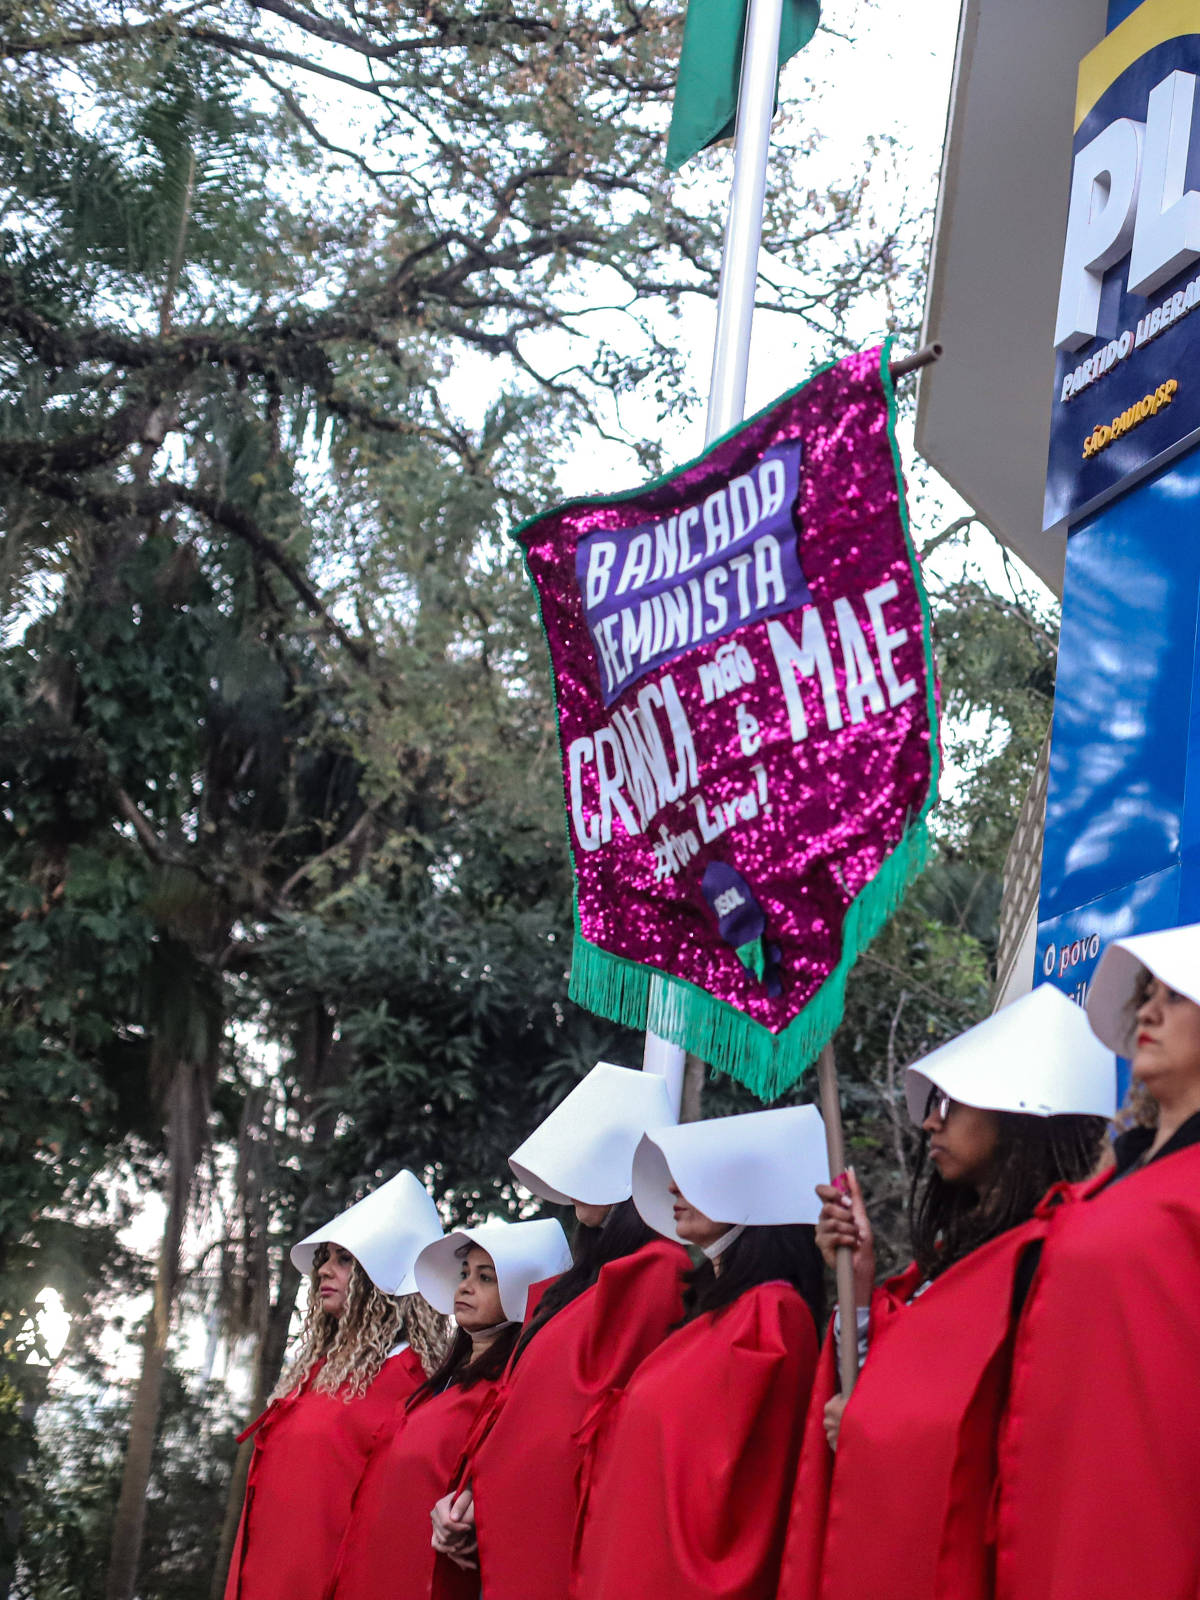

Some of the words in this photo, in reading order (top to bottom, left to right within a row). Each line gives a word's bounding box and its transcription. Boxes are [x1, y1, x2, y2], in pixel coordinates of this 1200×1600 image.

[1060, 330, 1135, 402] PARTIDO
[1081, 424, 1112, 459] SÃO
[586, 459, 786, 611] BANCADA
[698, 640, 757, 704] não
[1043, 943, 1056, 976] O
[1058, 933, 1100, 978] povo
